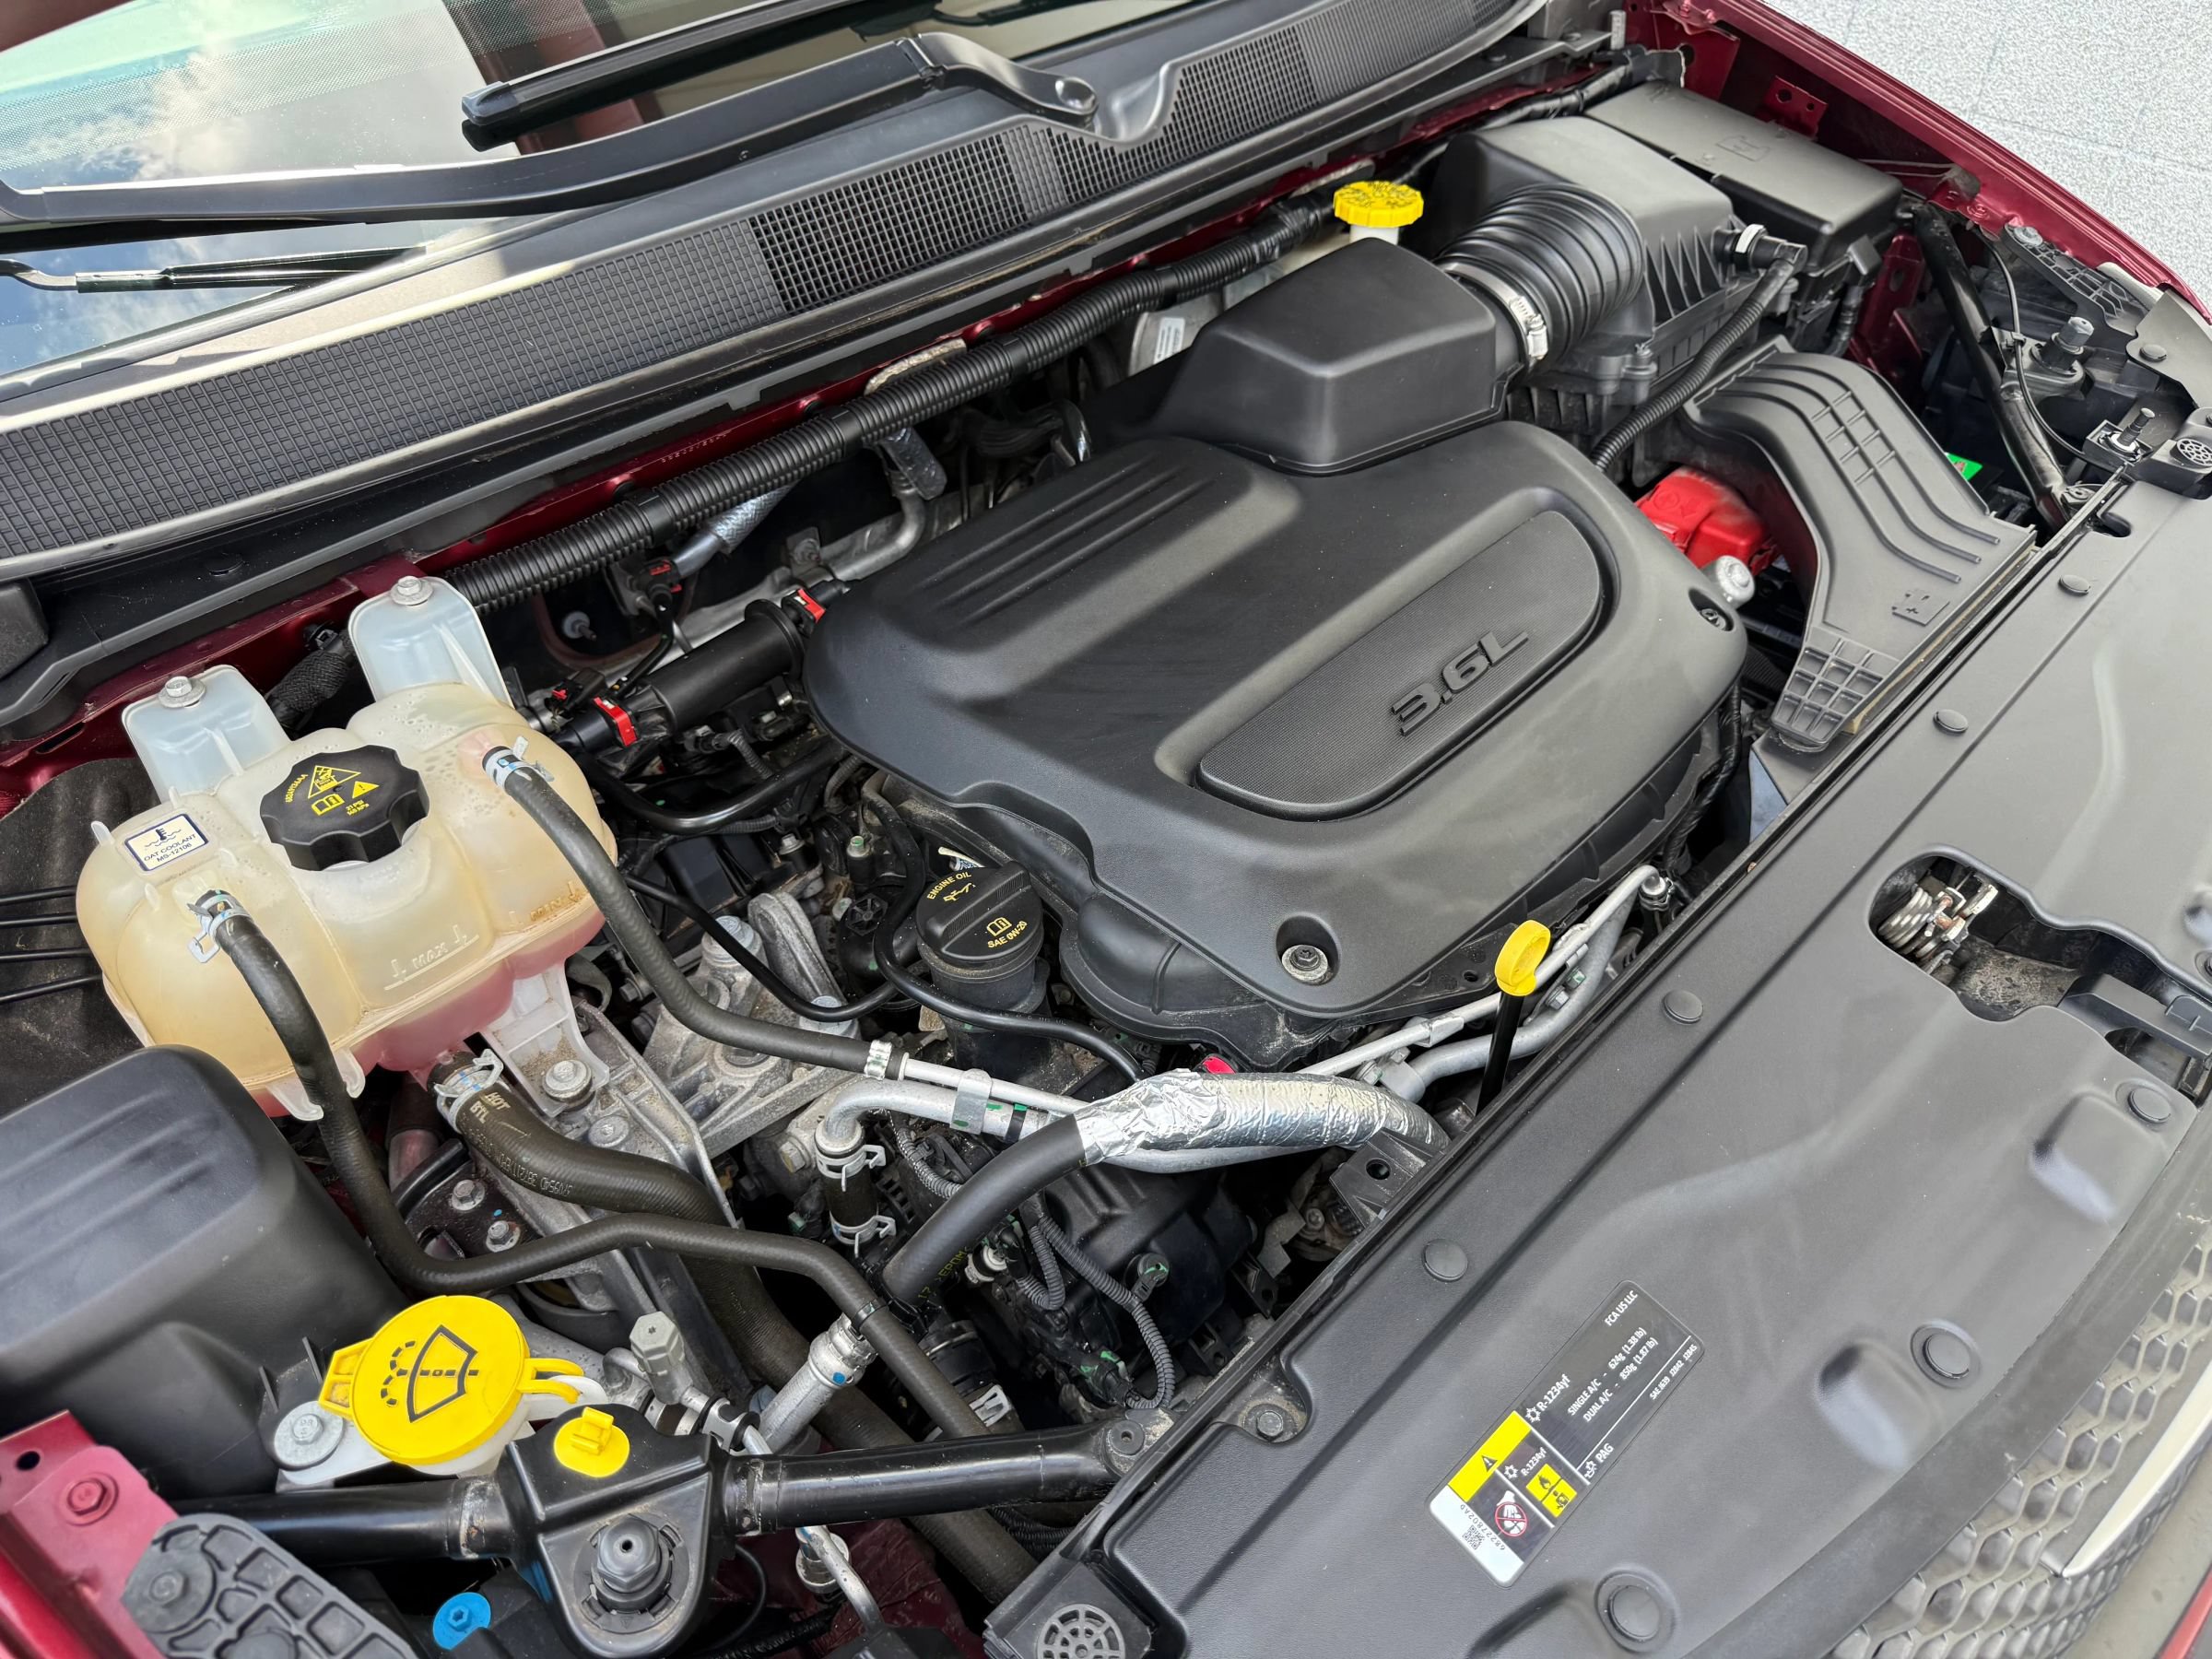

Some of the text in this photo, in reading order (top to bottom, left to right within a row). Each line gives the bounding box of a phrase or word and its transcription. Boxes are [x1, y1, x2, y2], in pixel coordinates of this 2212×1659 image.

[1392, 630, 1528, 736] 3.6L
[144, 833, 196, 862] OAT COOLANT
[927, 871, 972, 900] ENGINE OIL
[987, 920, 1028, 948] SAE 0W-20
[412, 941, 450, 969] MAX
[469, 1100, 490, 1124] BTL
[483, 1091, 512, 1111] HOT
[1605, 1289, 1638, 1326] FCA US LLC
[1568, 1390, 1592, 1416] SINGLE
[1587, 1378, 1602, 1394] A/C
[1608, 1352, 1626, 1370] 624g
[1622, 1336, 1639, 1355] (1.38
[1634, 1326, 1647, 1341] lb)
[1583, 1402, 1603, 1422] DUAL
[1598, 1389, 1613, 1405] A/C
[1619, 1362, 1638, 1380] 850g
[1633, 1347, 1650, 1365] (1.87
[1645, 1336, 1659, 1351] lb)
[1536, 1373, 1571, 1411] R-1234yf
[1521, 1447, 1547, 1477] R-1234yf
[1595, 1442, 1615, 1464] PAG
